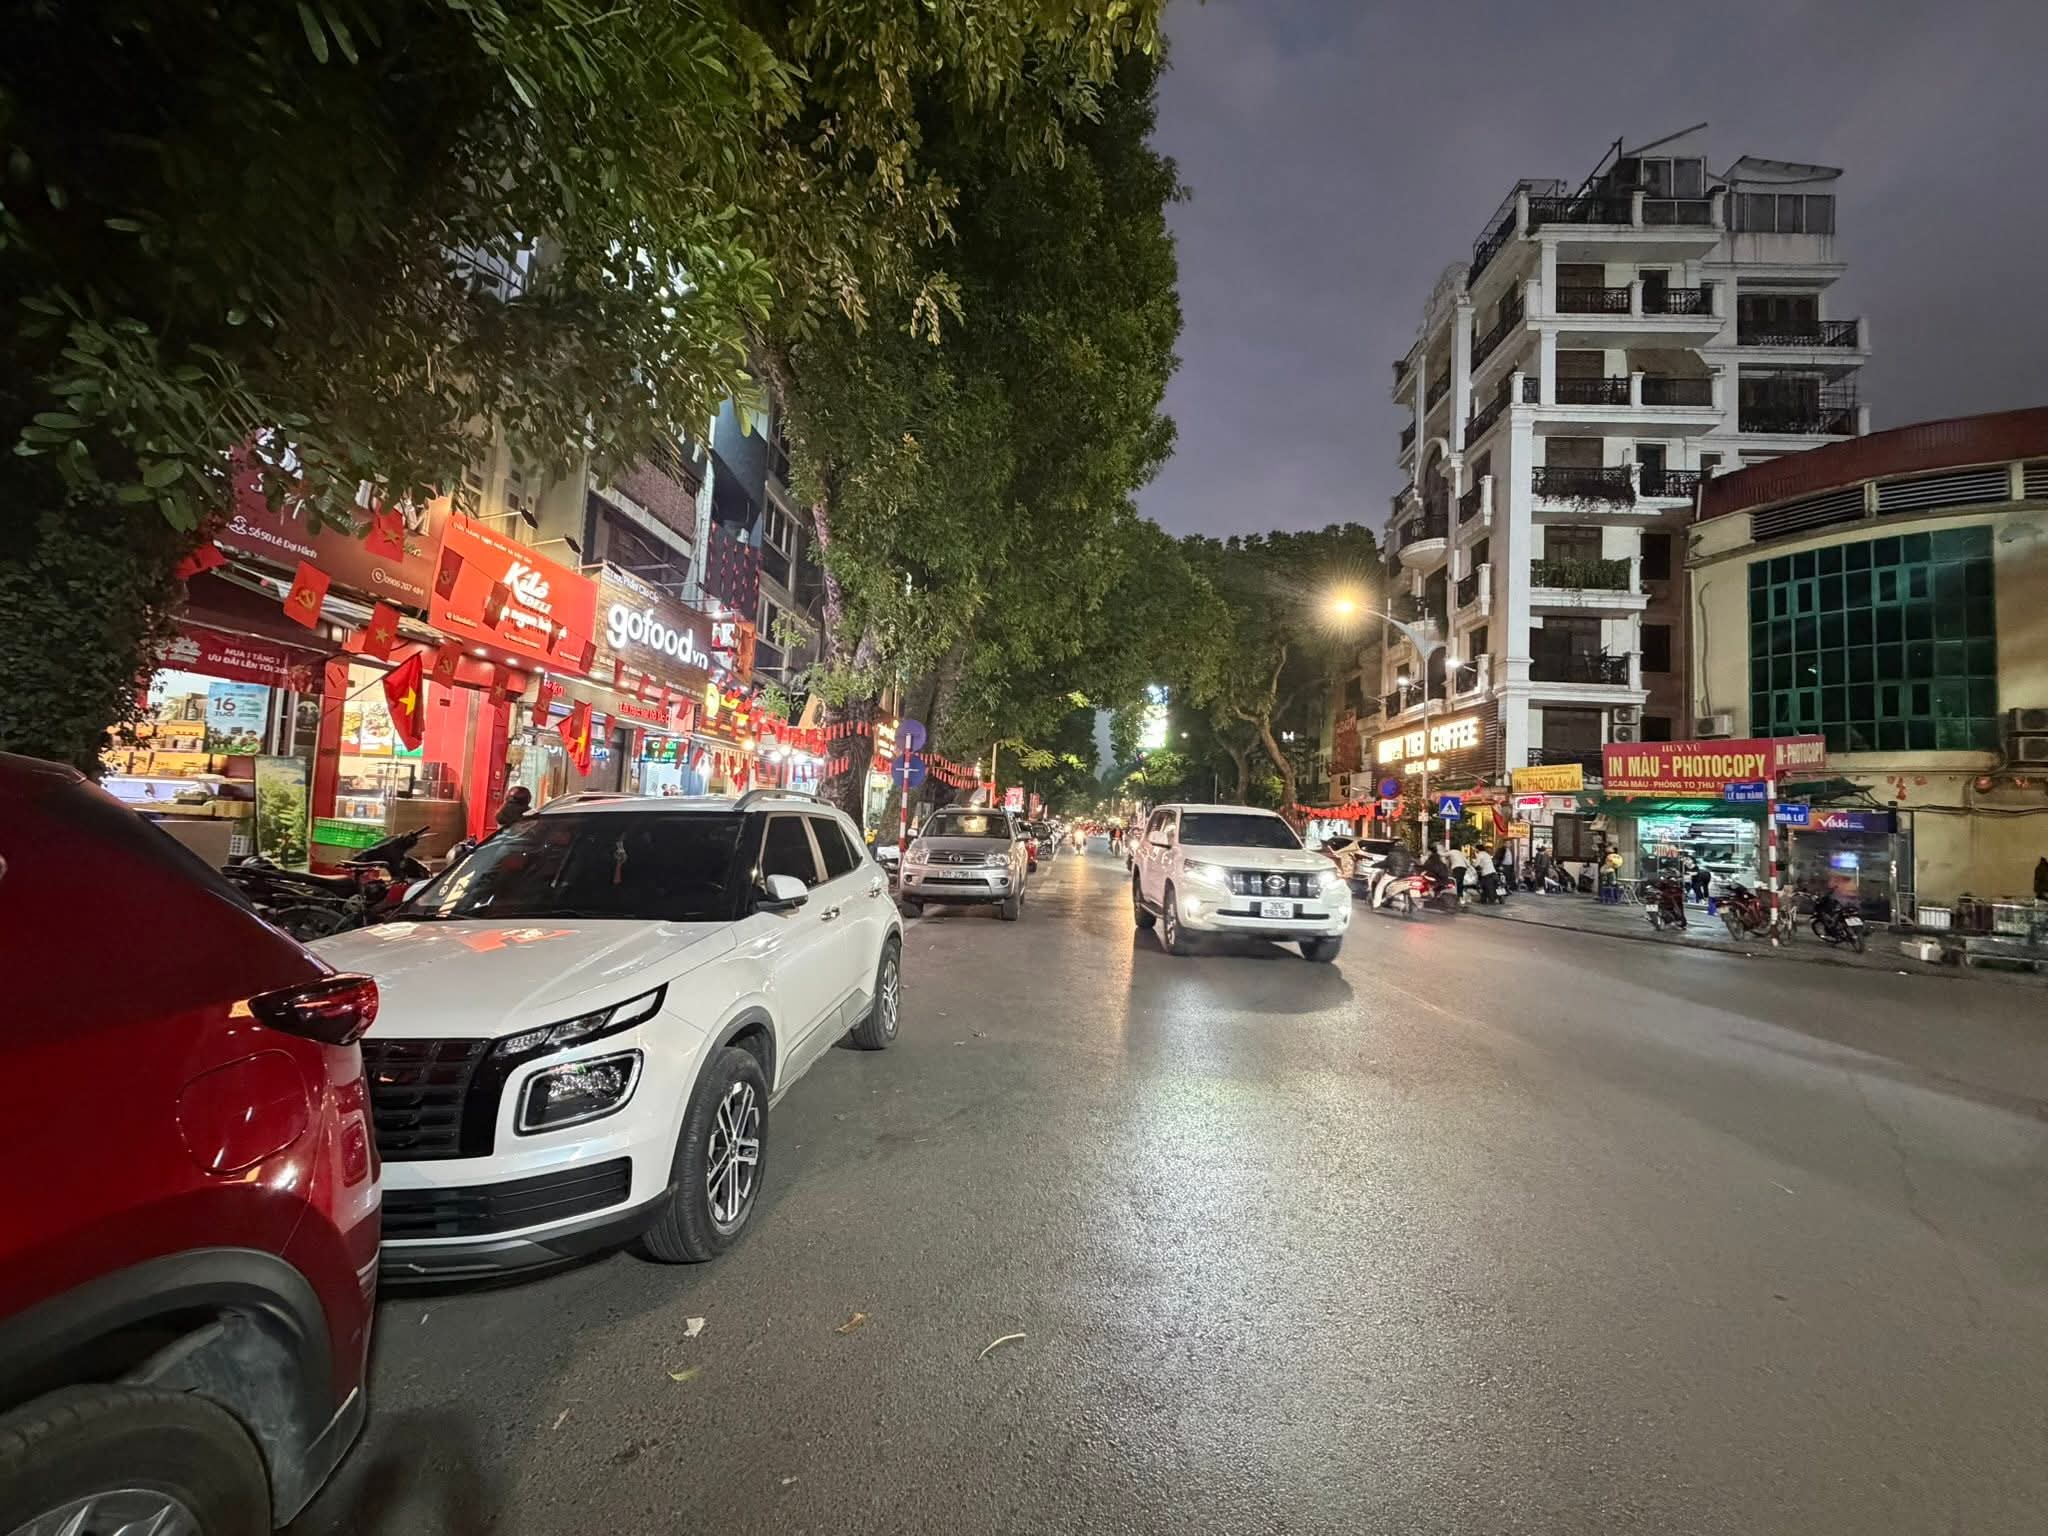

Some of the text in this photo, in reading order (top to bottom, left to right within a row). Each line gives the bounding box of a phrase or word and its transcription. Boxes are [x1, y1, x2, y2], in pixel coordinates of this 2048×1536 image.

[213, 697, 237, 712] 16
[1608, 756, 1623, 778] IN
[1627, 751, 1660, 778] MÀU
[1672, 753, 1766, 778] PHOTOCOPY
[1608, 780, 1629, 788] SCAN
[1818, 815, 1849, 829] Vikki
